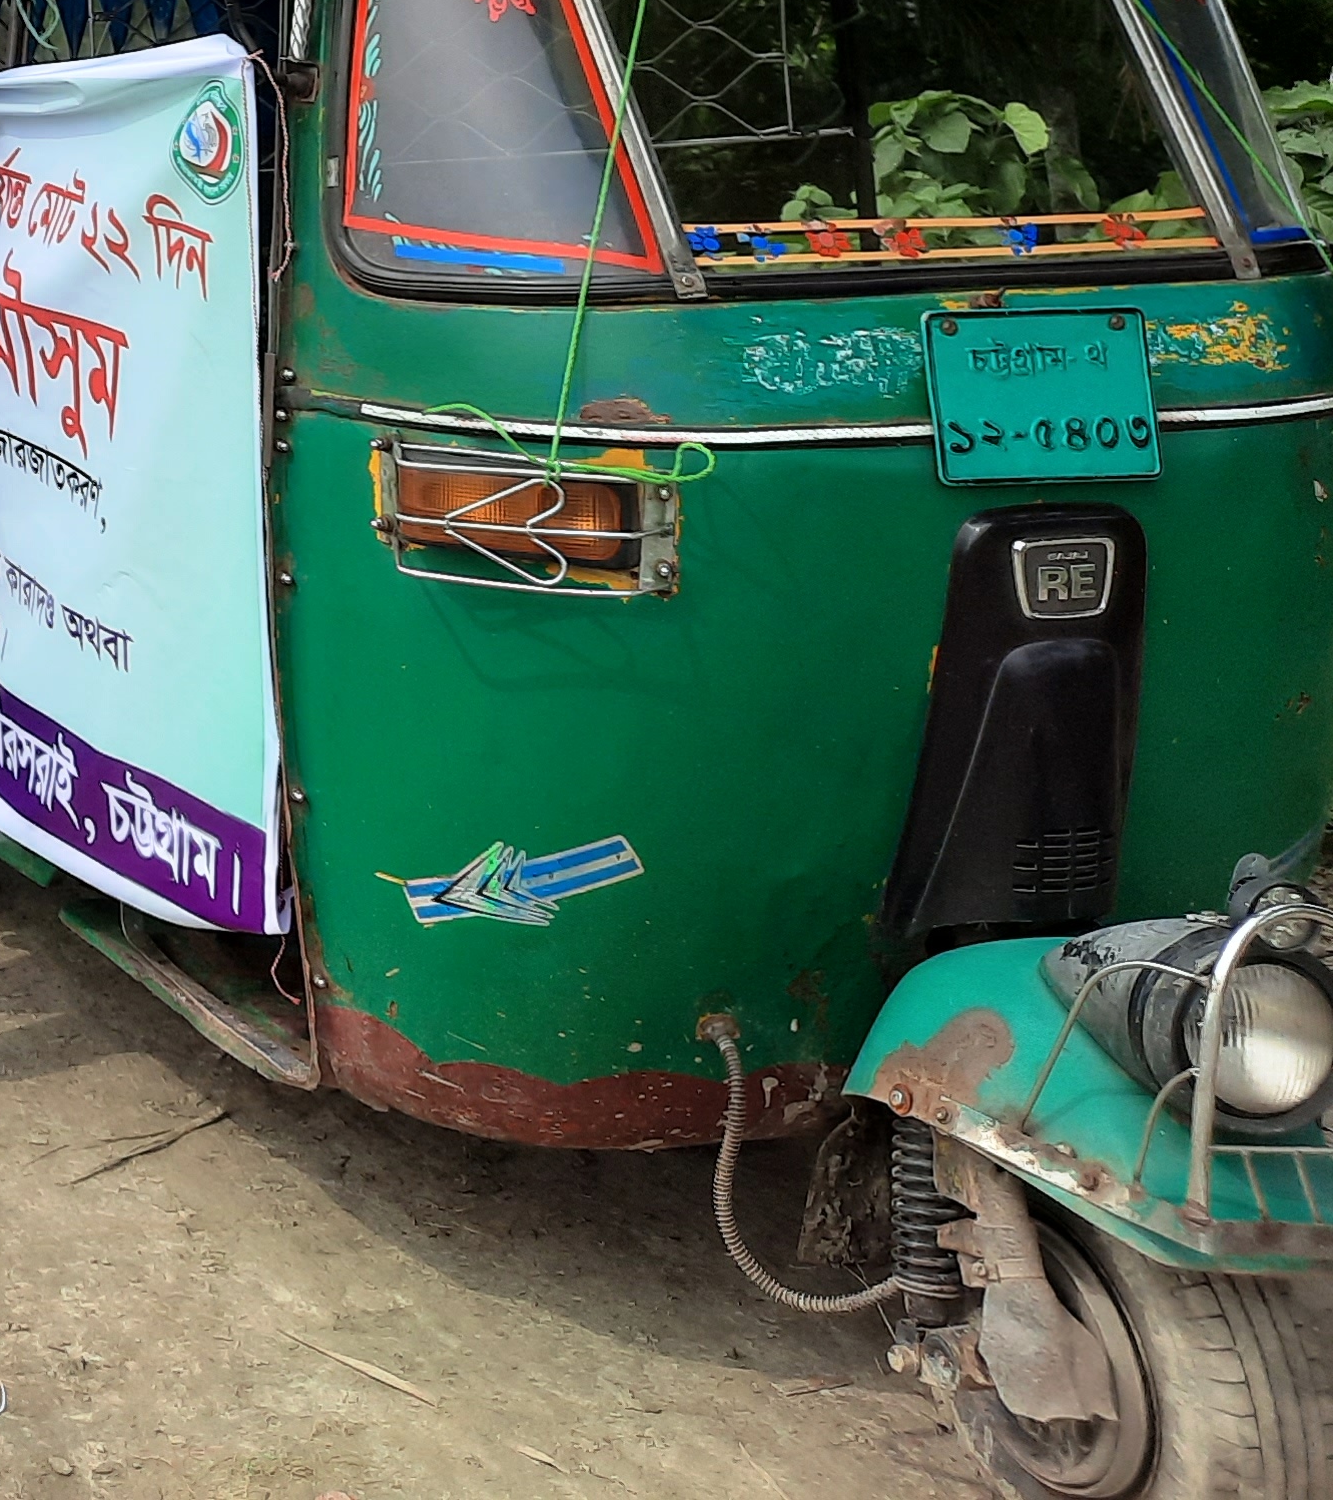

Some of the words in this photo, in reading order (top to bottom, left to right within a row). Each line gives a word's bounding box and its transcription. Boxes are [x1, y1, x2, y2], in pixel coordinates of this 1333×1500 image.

[28, 168, 85, 247] মোট
[82, 201, 140, 283] ২২
[142, 194, 213, 301] দিন
[1038, 563, 1097, 601] RE
[60, 603, 134, 673] অথবা
